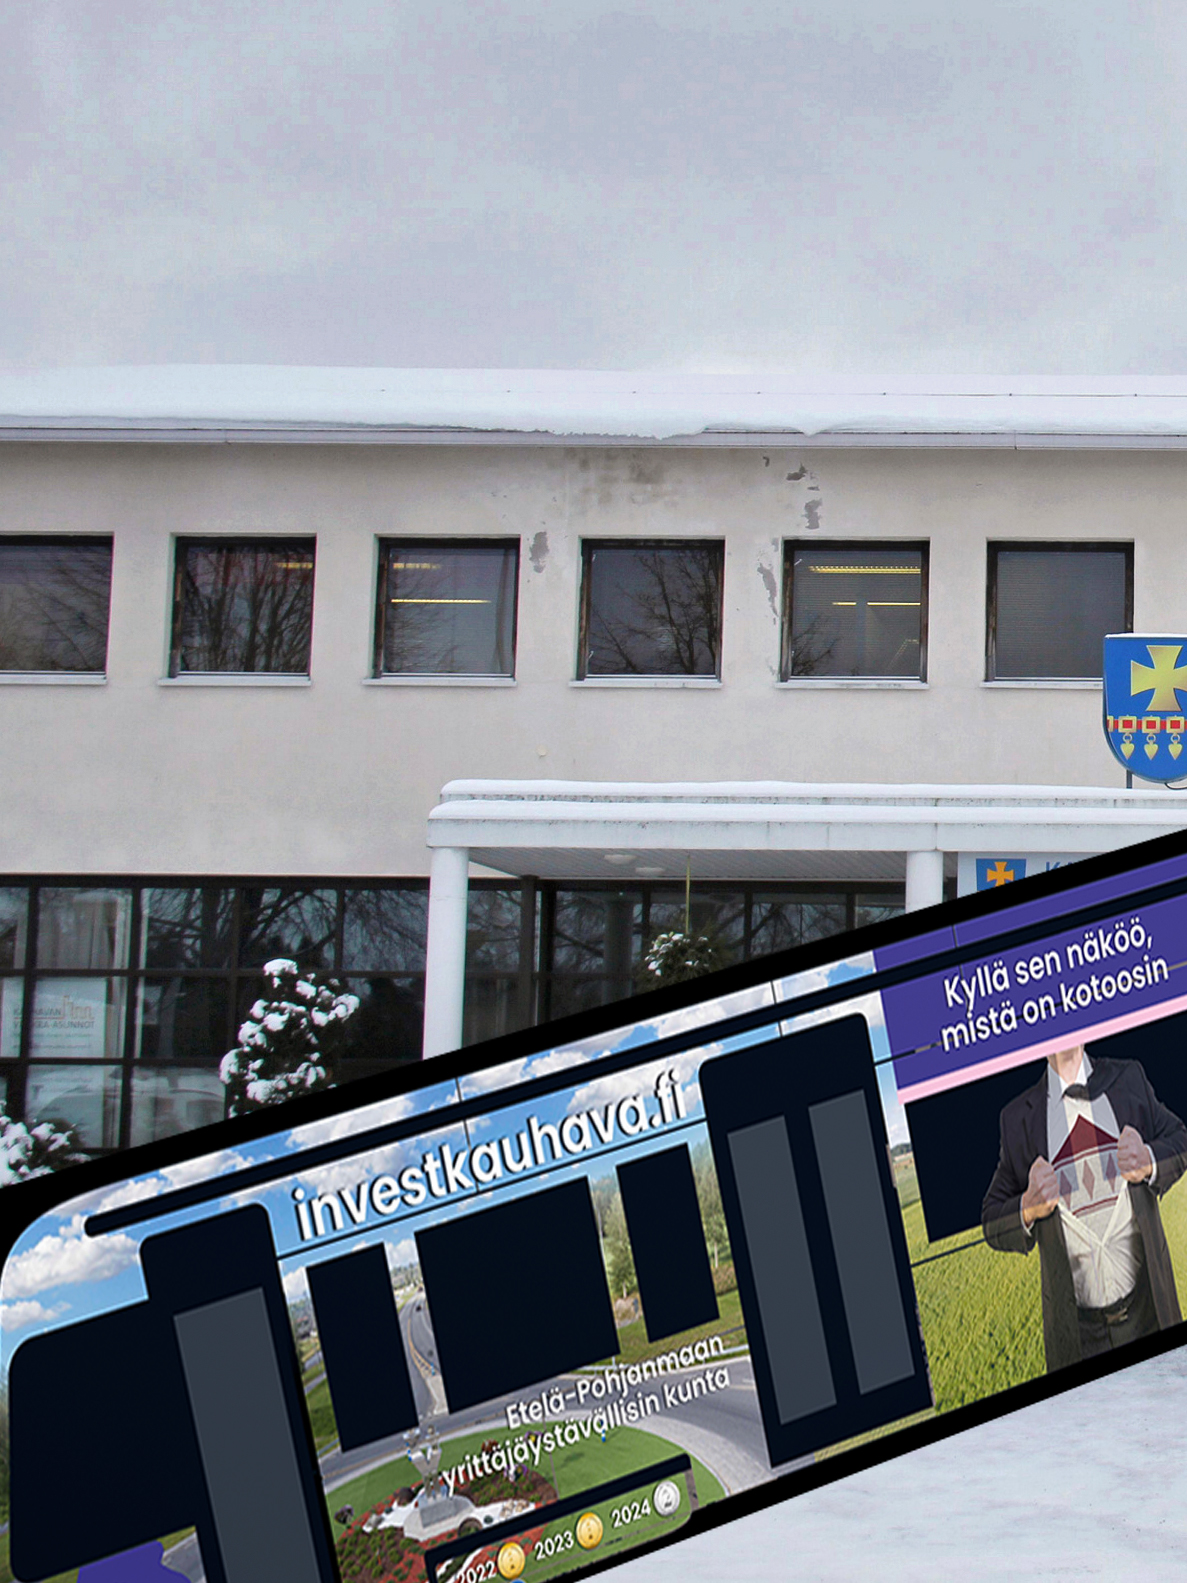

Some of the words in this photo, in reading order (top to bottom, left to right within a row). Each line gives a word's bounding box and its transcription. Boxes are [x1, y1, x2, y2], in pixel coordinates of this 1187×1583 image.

[941, 1000, 1017, 1051] mistä
[1022, 992, 1056, 1025] on
[1060, 955, 1169, 1016] kotoosin
[944, 957, 1010, 1014] Kyllä
[1015, 950, 1062, 984] sen
[1066, 917, 1153, 970] näköö,
[293, 1069, 688, 1240] investkauhava.fi
[506, 1335, 724, 1429] Etelä-Pohjanmaan
[441, 1392, 660, 1497] yrittäjäystävällisin
[663, 1368, 731, 1409] kunta
[534, 1531, 575, 1560] 2023
[611, 1499, 652, 1528] 2024
